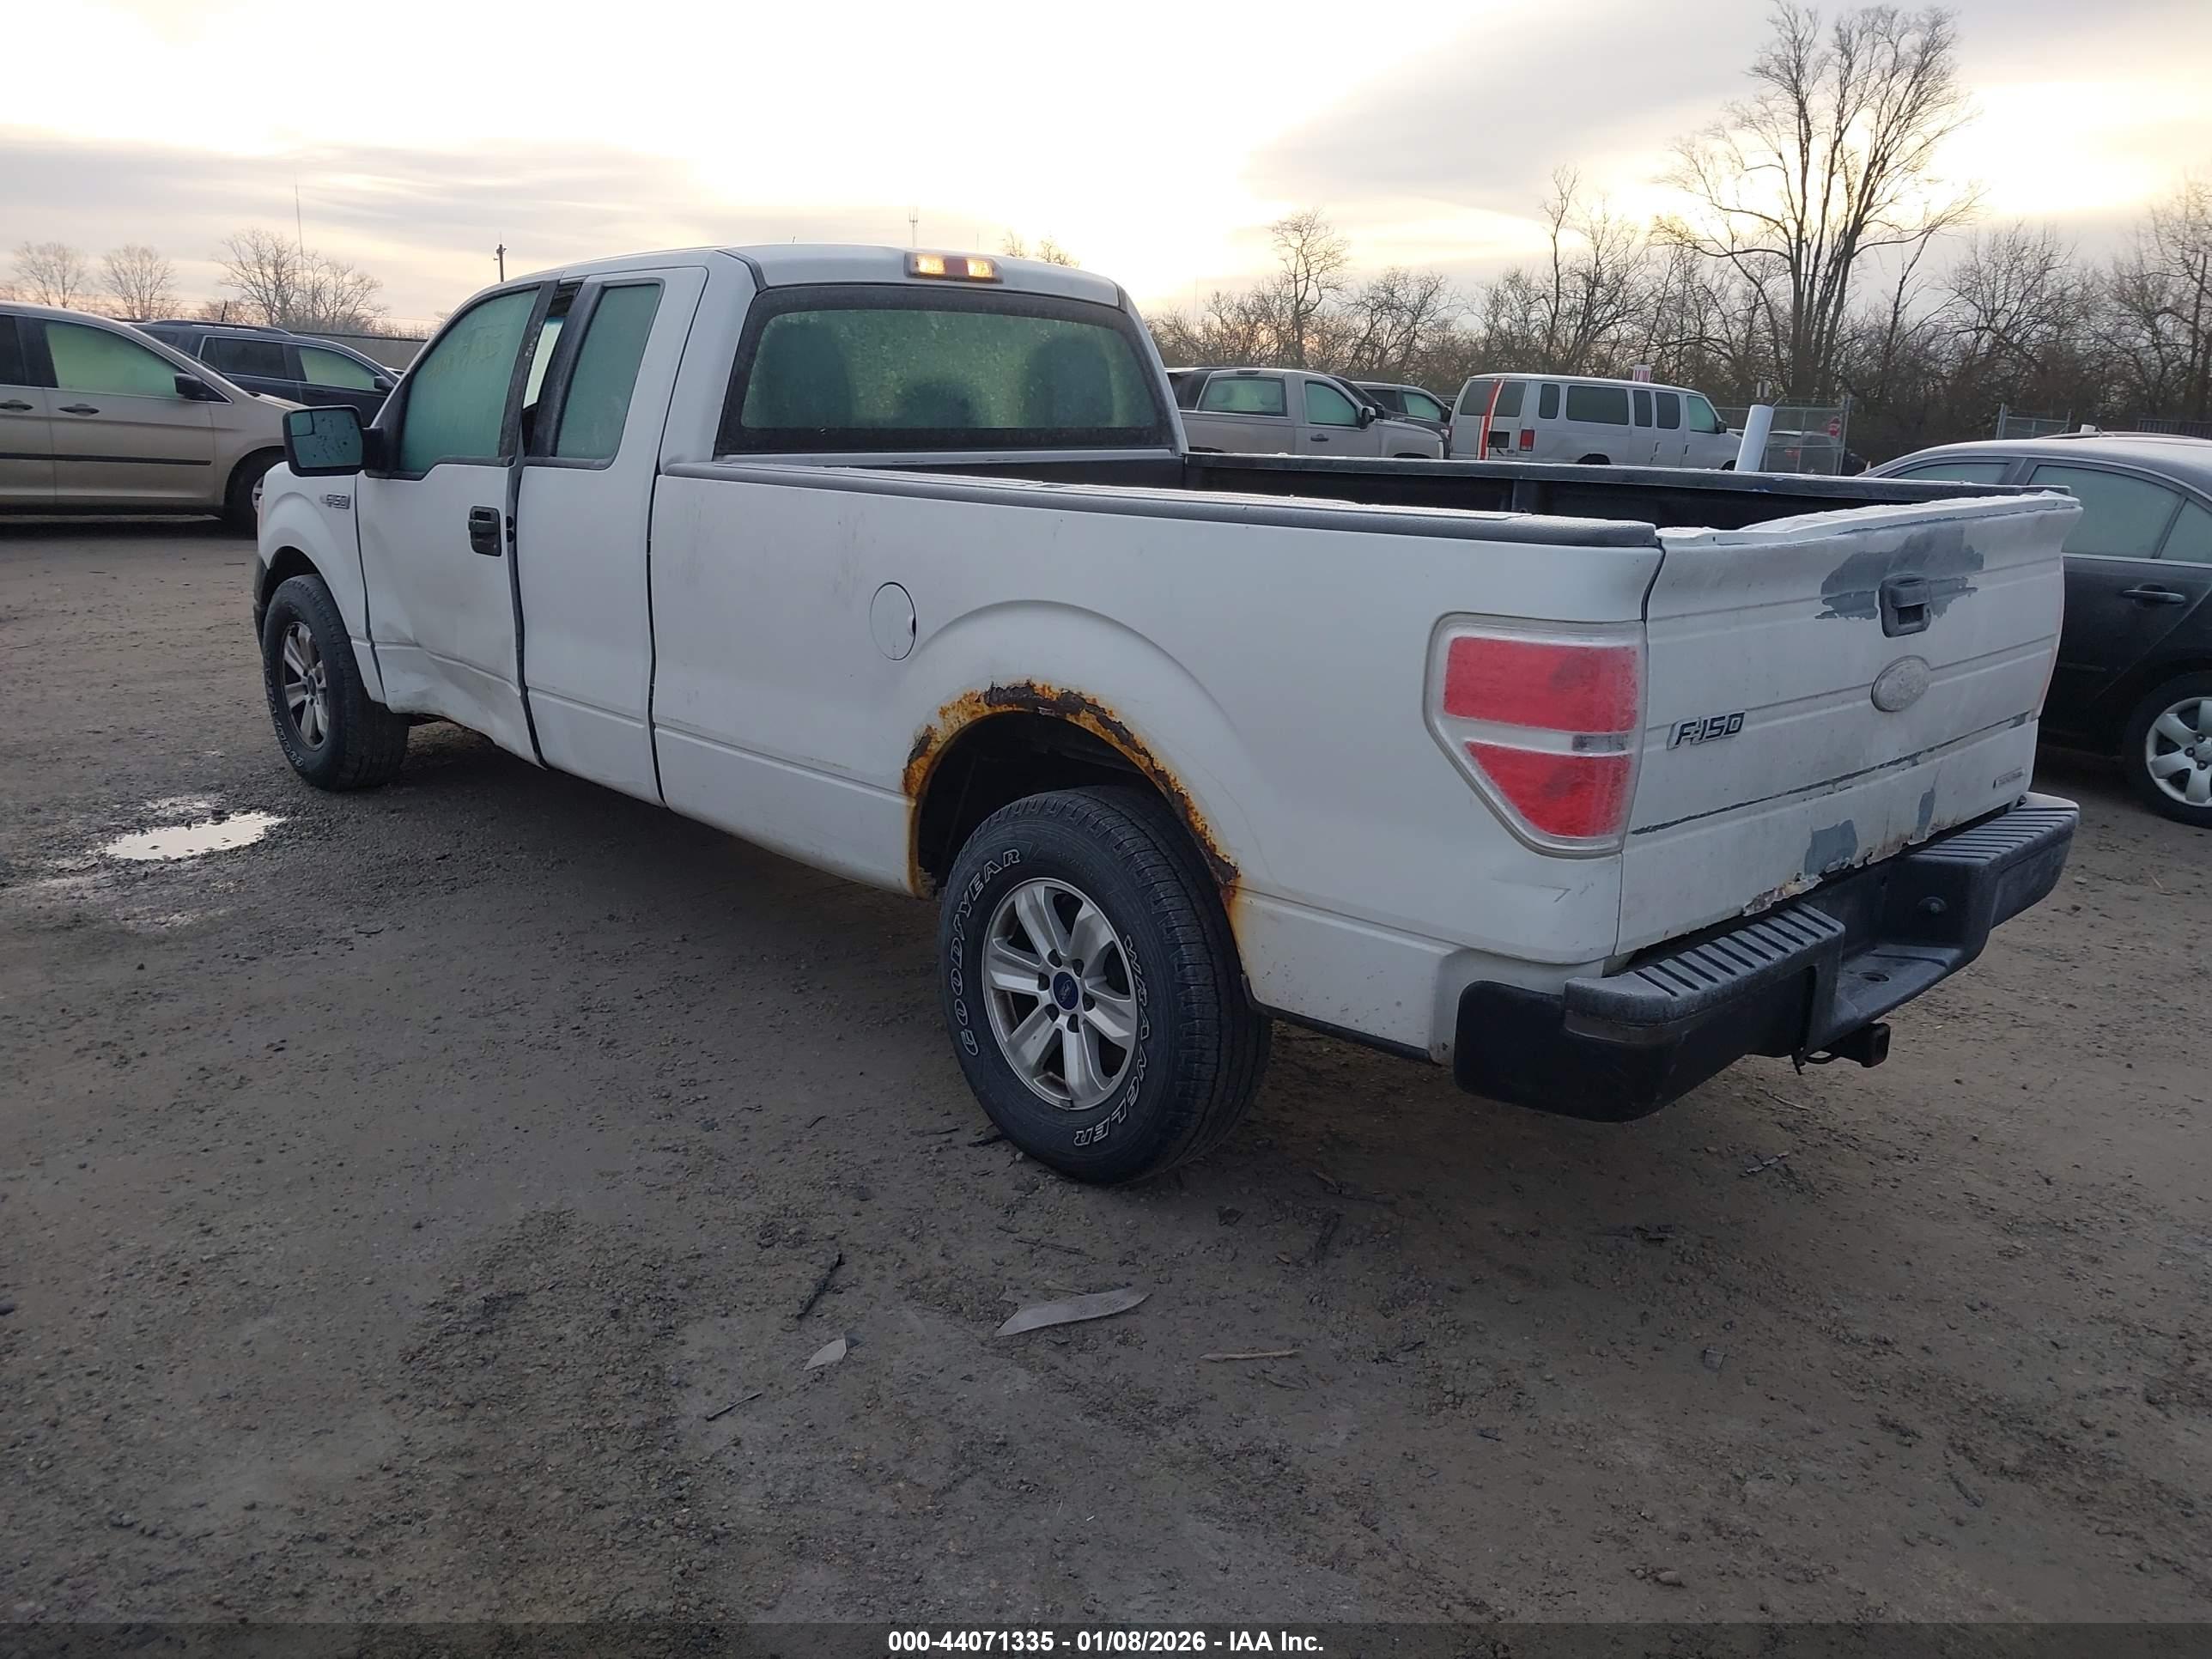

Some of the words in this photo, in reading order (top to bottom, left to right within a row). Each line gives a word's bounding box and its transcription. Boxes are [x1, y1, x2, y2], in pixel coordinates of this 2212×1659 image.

[1672, 711, 1746, 747] F-150
[950, 848, 1020, 1056] GOODYEAR
[1073, 934, 1150, 1146] WRANGLER
